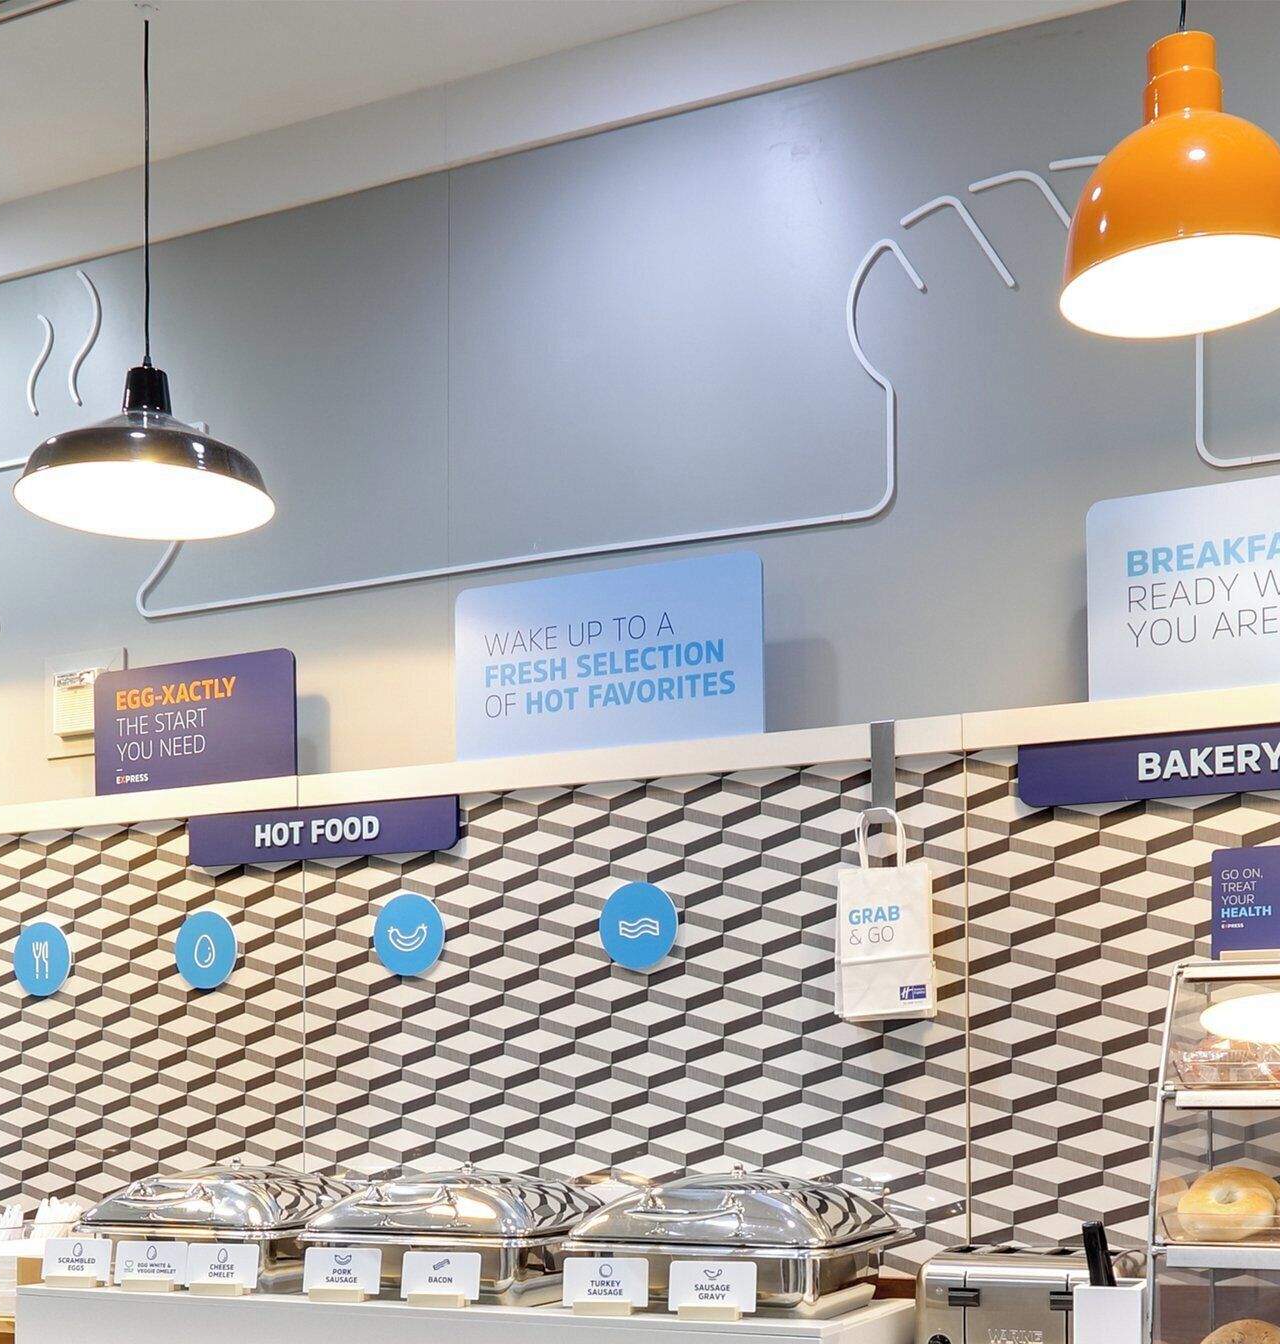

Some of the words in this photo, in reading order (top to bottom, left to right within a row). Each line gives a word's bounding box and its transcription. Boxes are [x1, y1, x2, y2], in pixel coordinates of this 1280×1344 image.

[1128, 573, 1239, 613] READY
[484, 625, 558, 657] WAKE
[568, 620, 603, 647] UP
[612, 615, 646, 641] TO
[657, 611, 674, 636] A
[1127, 615, 1197, 648] YOU
[1212, 606, 1278, 640] ARE
[485, 656, 567, 688] FRESH
[576, 638, 724, 678] SELECTION
[116, 676, 236, 711] EGG-XACTLY
[485, 693, 516, 718] OF
[526, 687, 579, 715] HOT
[588, 670, 736, 708] FAVORITES
[116, 715, 149, 737] THE
[154, 707, 207, 733] START
[116, 740, 153, 762] YOU
[160, 734, 206, 758] NEED
[116, 773, 149, 785] EXPRESS
[254, 820, 304, 848] HOT
[311, 815, 380, 844] FOOD
[1221, 869, 1239, 880] GO
[1242, 868, 1263, 879] ON,
[1221, 881, 1257, 892] TREAT
[1221, 894, 1255, 905] YOUR
[848, 905, 900, 925] GRAB
[1221, 905, 1272, 918] HEALTH
[849, 929, 862, 945] &
[868, 925, 895, 943] GO
[325, 1276, 357, 1284] SAUSAGE
[428, 1276, 453, 1284] BACON
[694, 1284, 730, 1292] SAUSAGE
[587, 1288, 623, 1296] SAUSAGE
